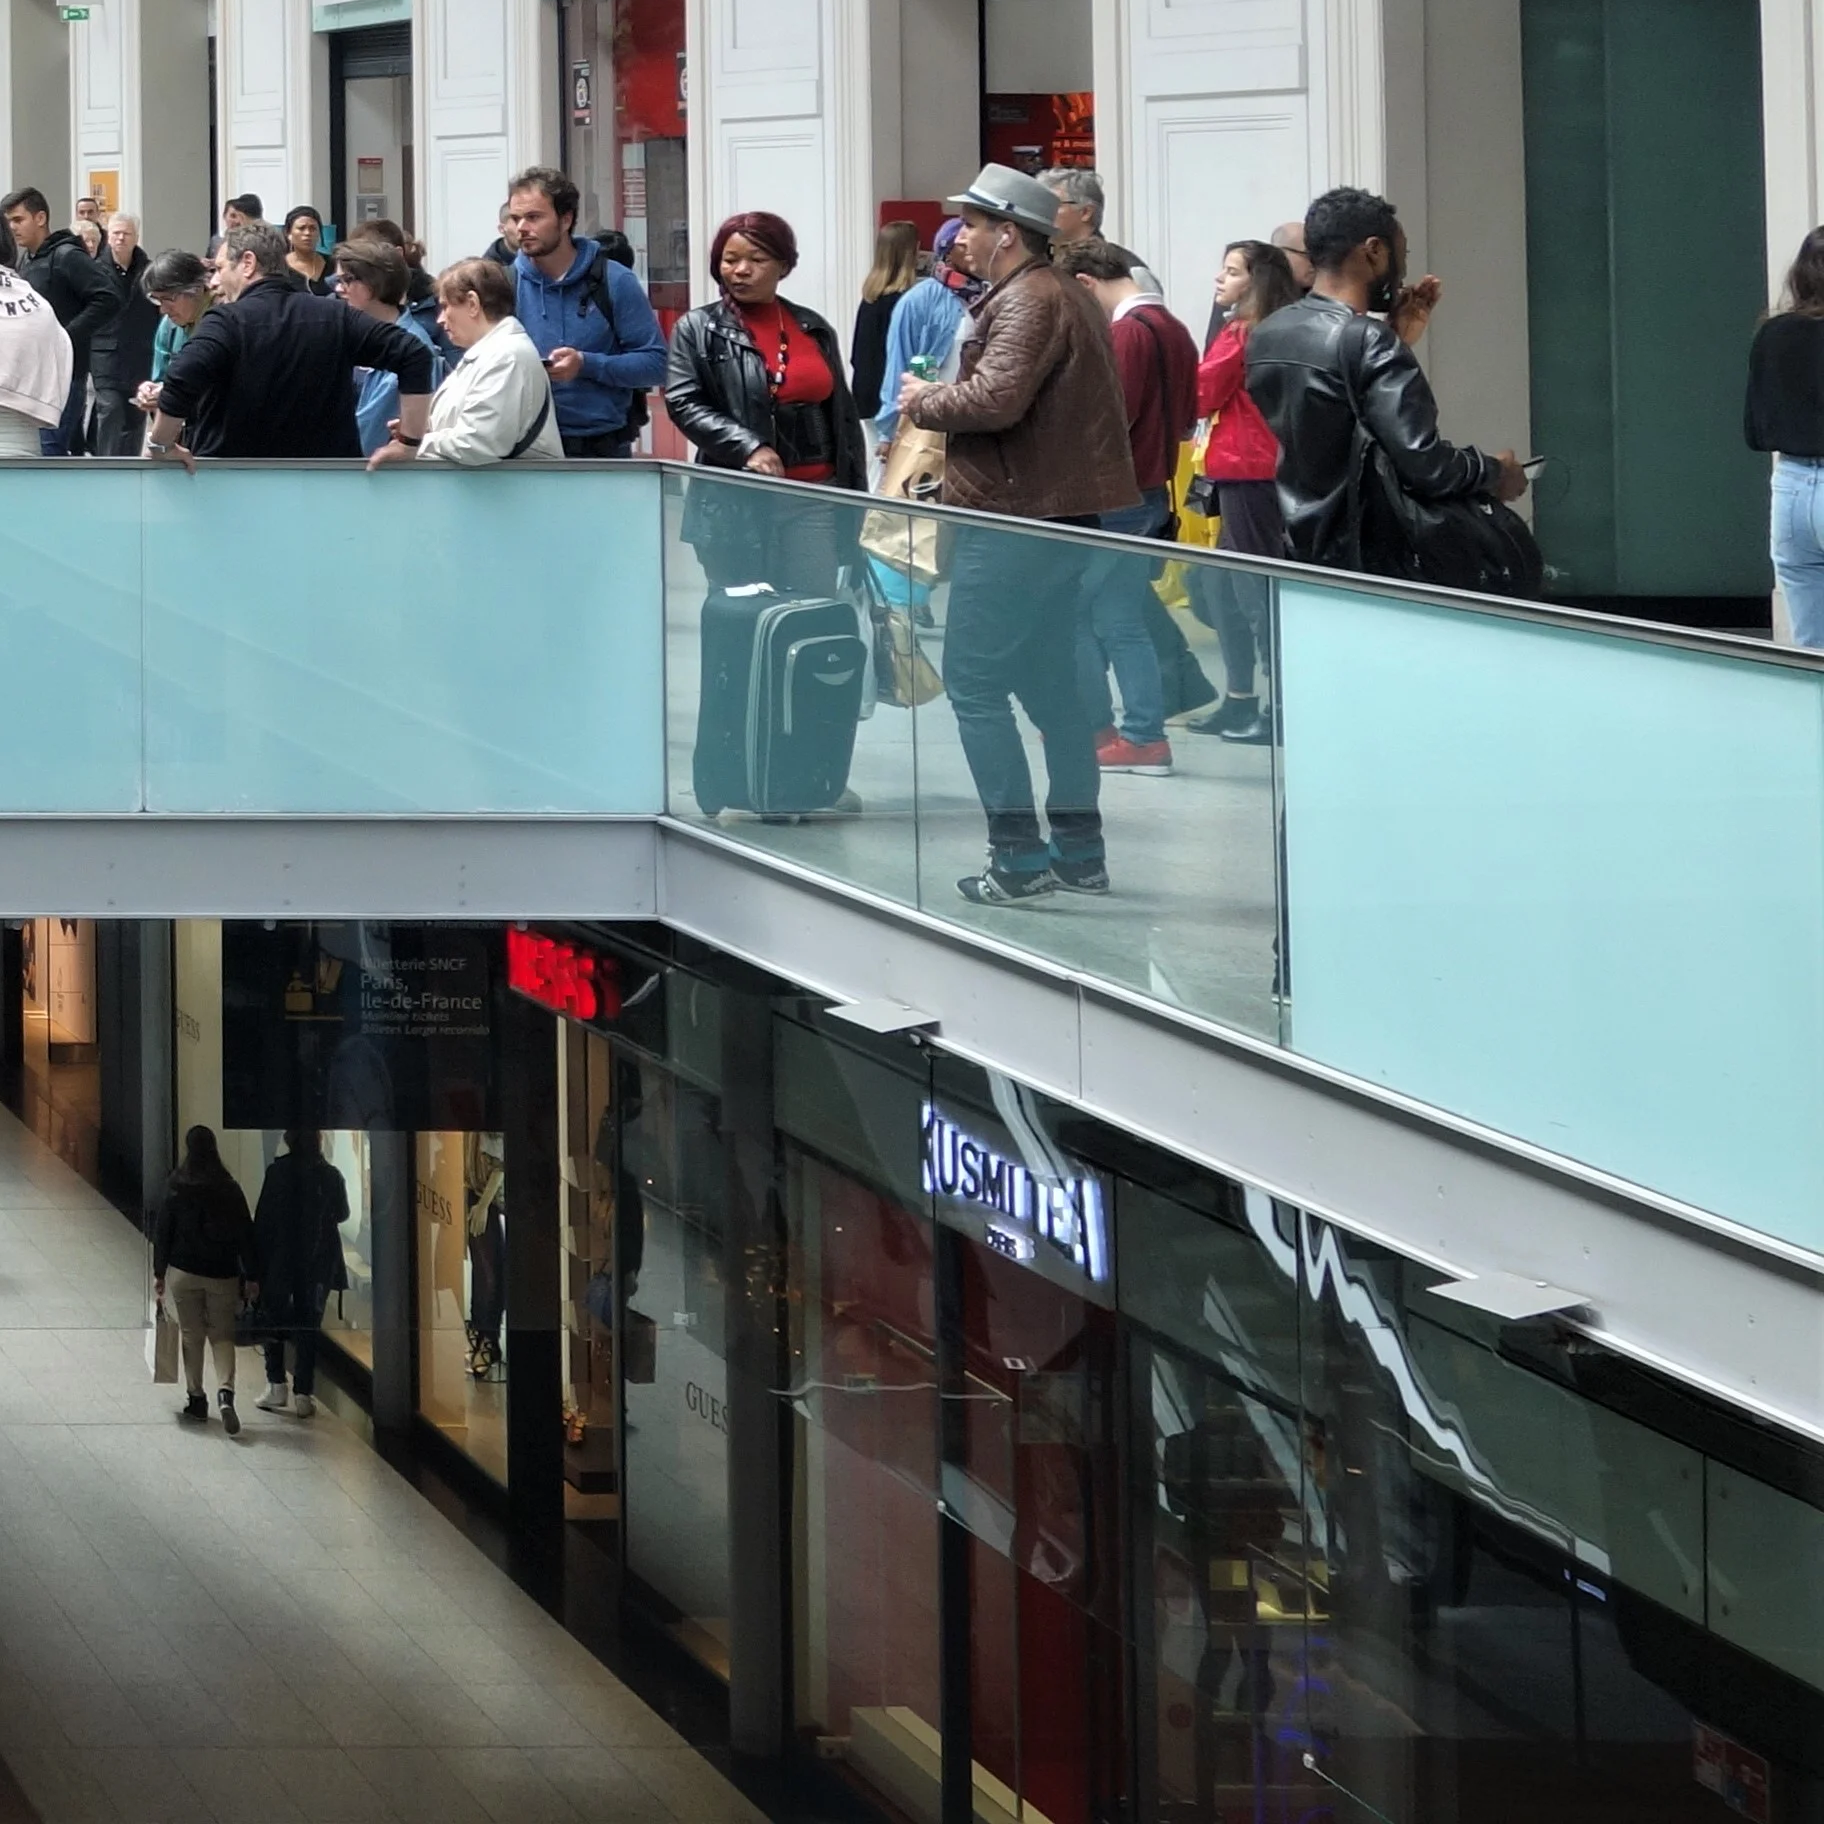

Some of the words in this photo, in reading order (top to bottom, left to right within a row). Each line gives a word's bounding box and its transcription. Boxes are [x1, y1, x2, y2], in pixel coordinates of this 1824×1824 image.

[429, 958, 467, 971] SNCF
[360, 973, 409, 993] Paris,
[360, 991, 483, 1010] Ile-de-France
[686, 1381, 728, 1435] GUES
